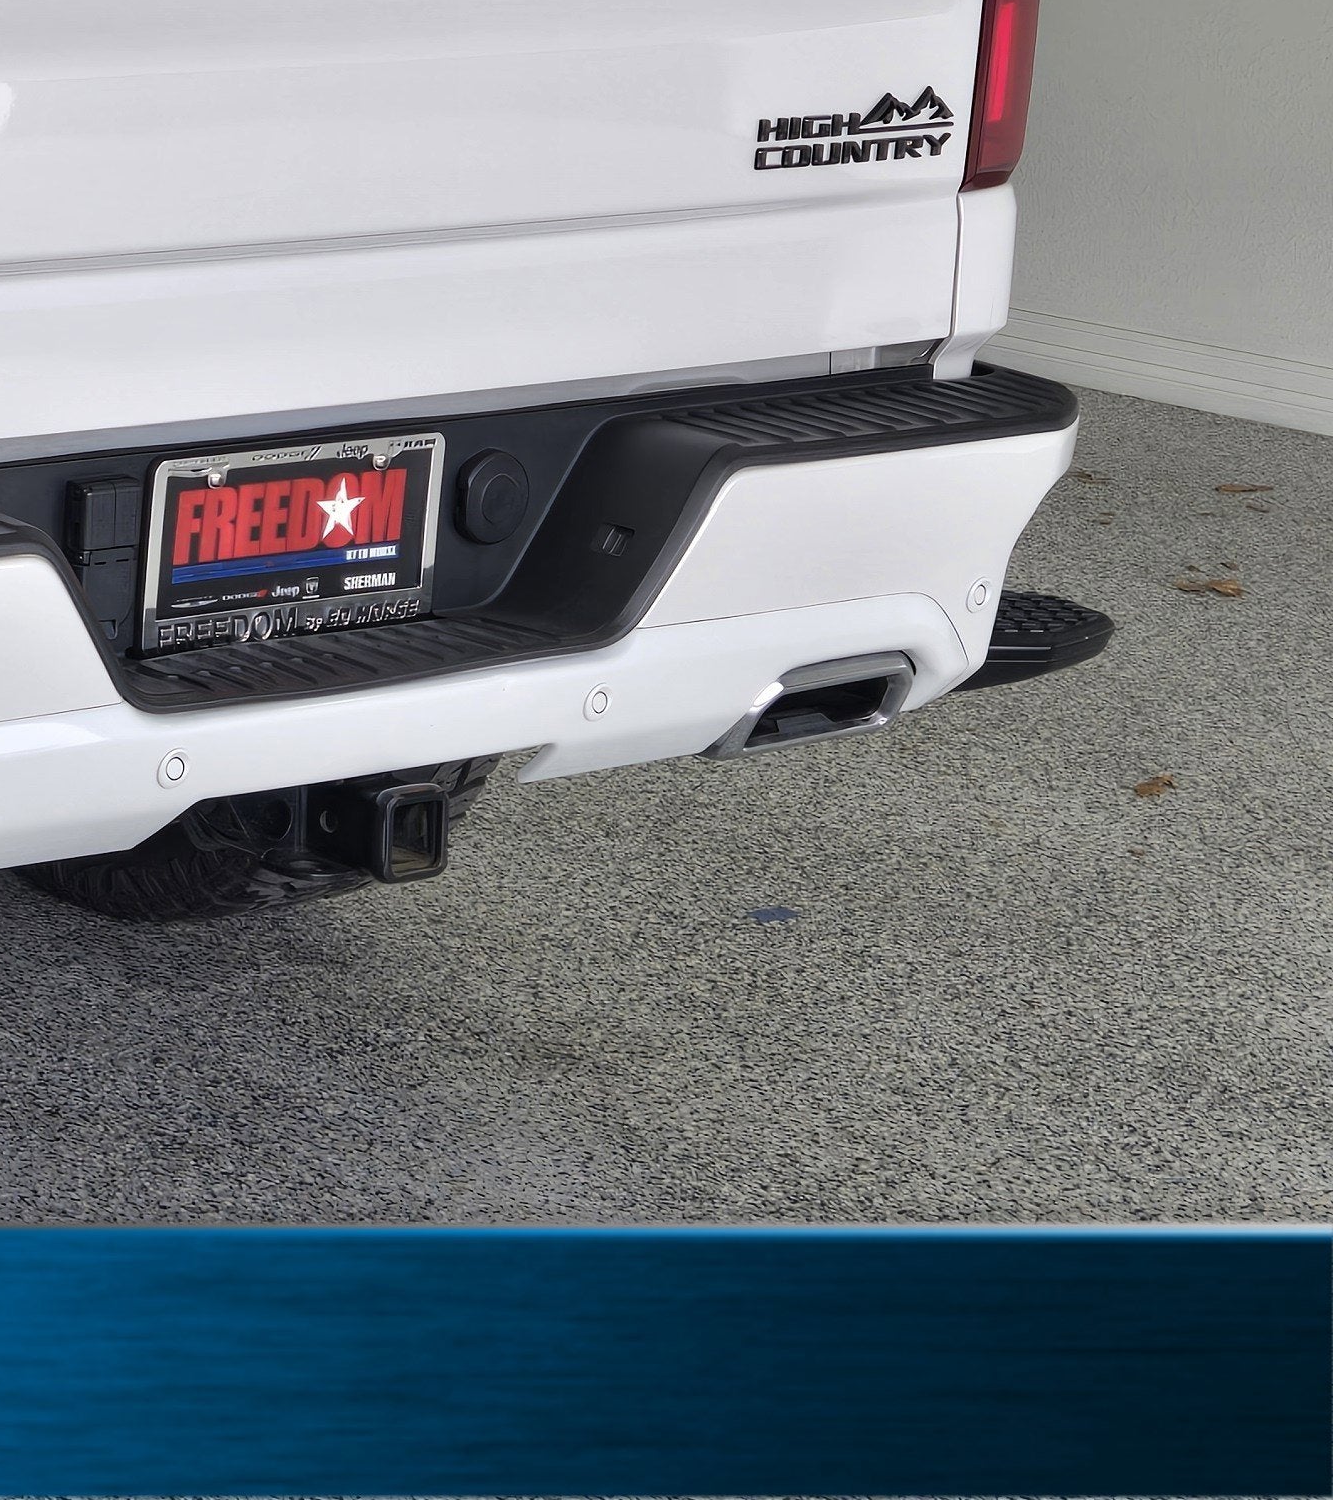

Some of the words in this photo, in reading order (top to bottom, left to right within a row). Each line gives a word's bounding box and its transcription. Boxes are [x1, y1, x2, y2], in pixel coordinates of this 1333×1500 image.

[757, 112, 862, 142] HIGH
[754, 132, 951, 170] COUNTRY
[172, 468, 408, 566] FREEDOM
[344, 573, 396, 590] SHERMAN
[157, 607, 298, 649] FREEDOM
